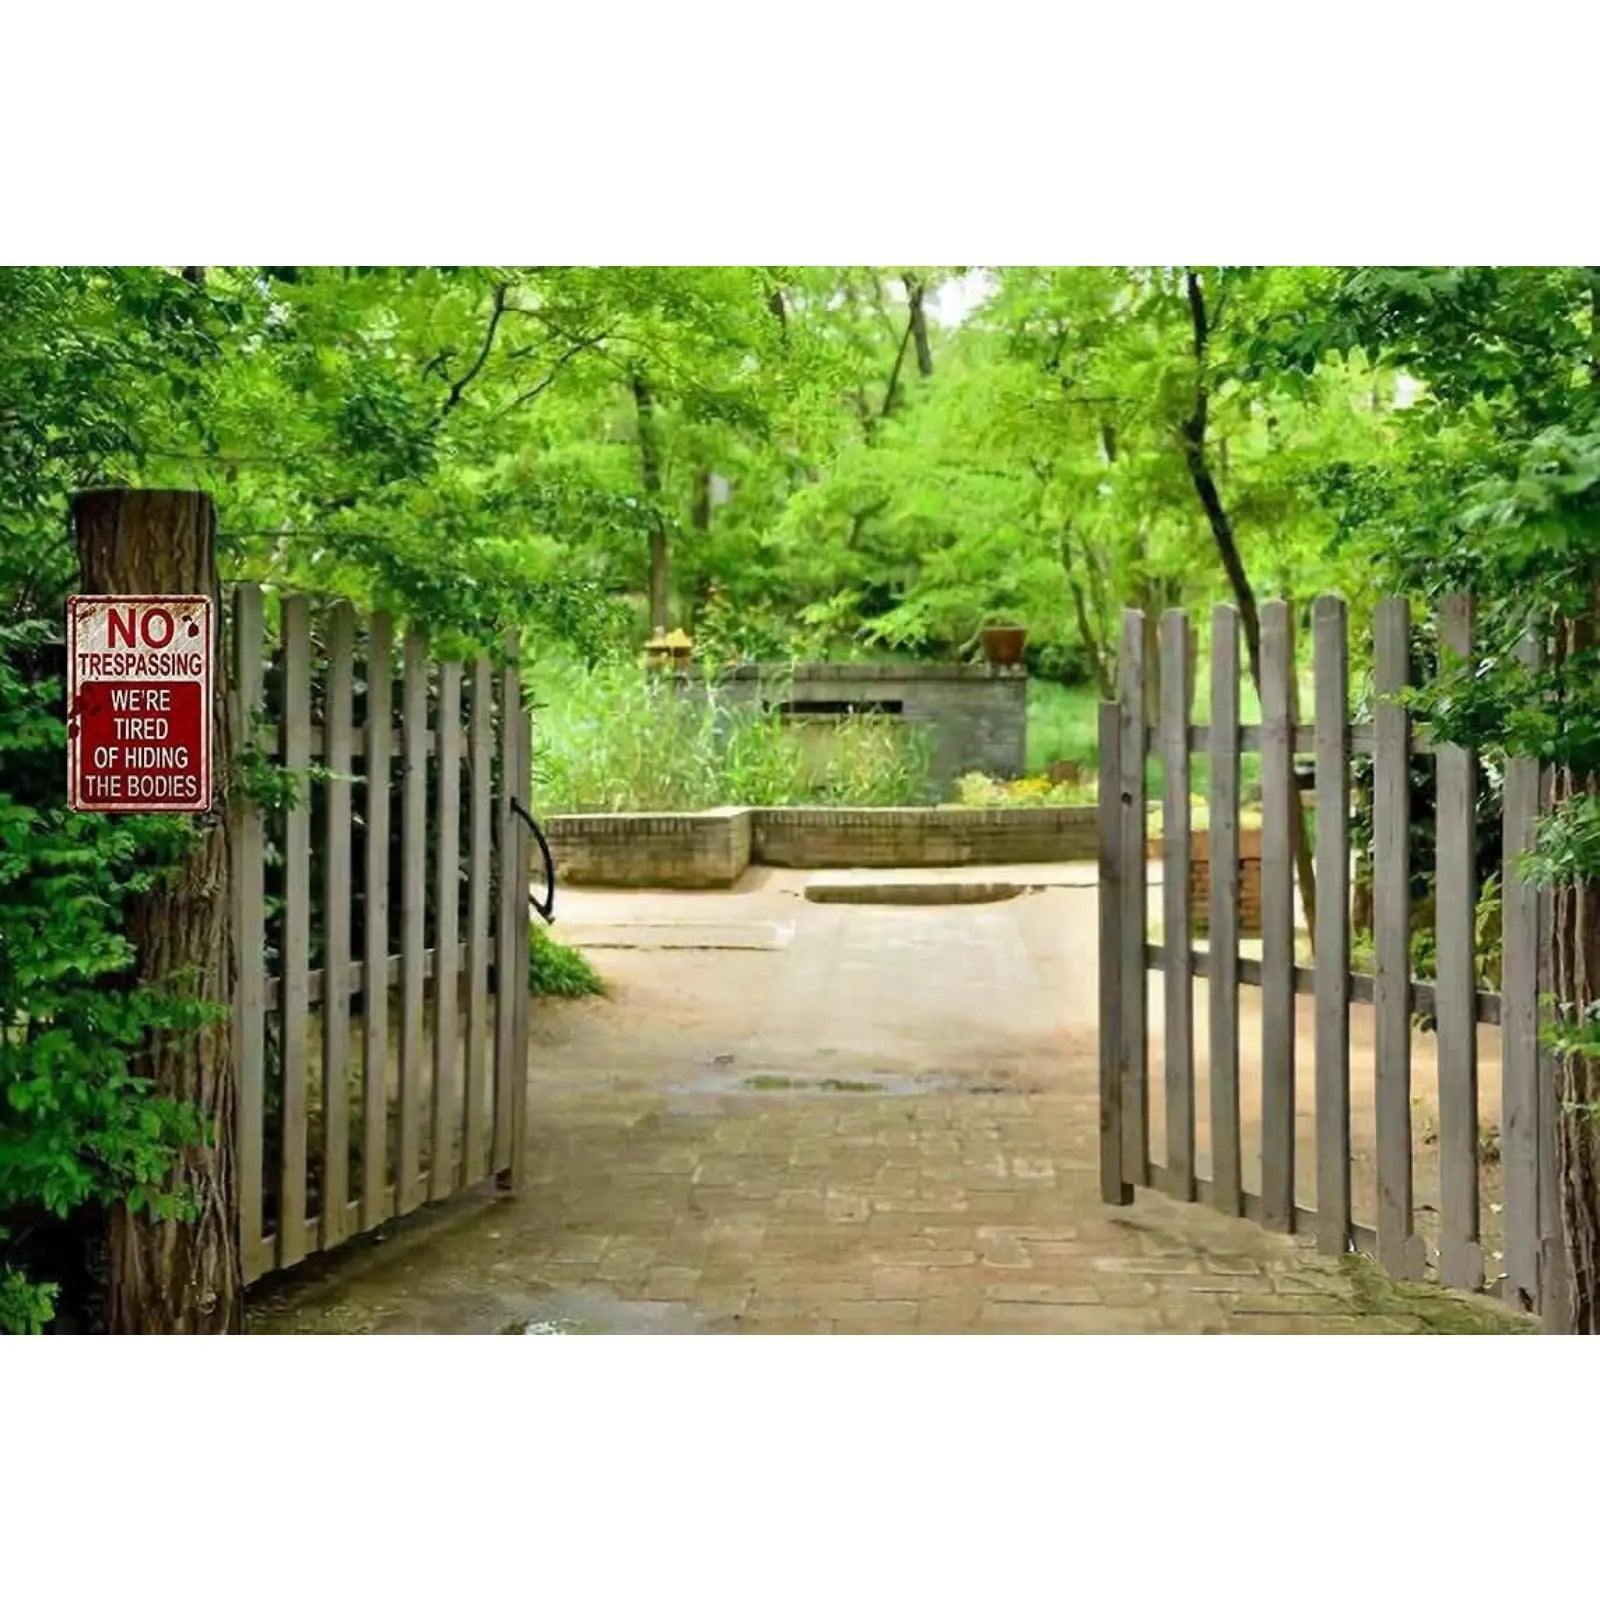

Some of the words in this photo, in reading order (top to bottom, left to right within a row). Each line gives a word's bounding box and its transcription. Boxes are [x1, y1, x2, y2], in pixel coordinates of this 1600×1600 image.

[107, 608, 175, 649] NO
[78, 653, 202, 676] TRESPASSING
[111, 689, 171, 711] WE'RE
[114, 718, 169, 740] TIRED
[94, 747, 118, 769] OF
[125, 747, 188, 769] HIDING
[85, 775, 121, 797] THE
[127, 775, 197, 797] BODIES
